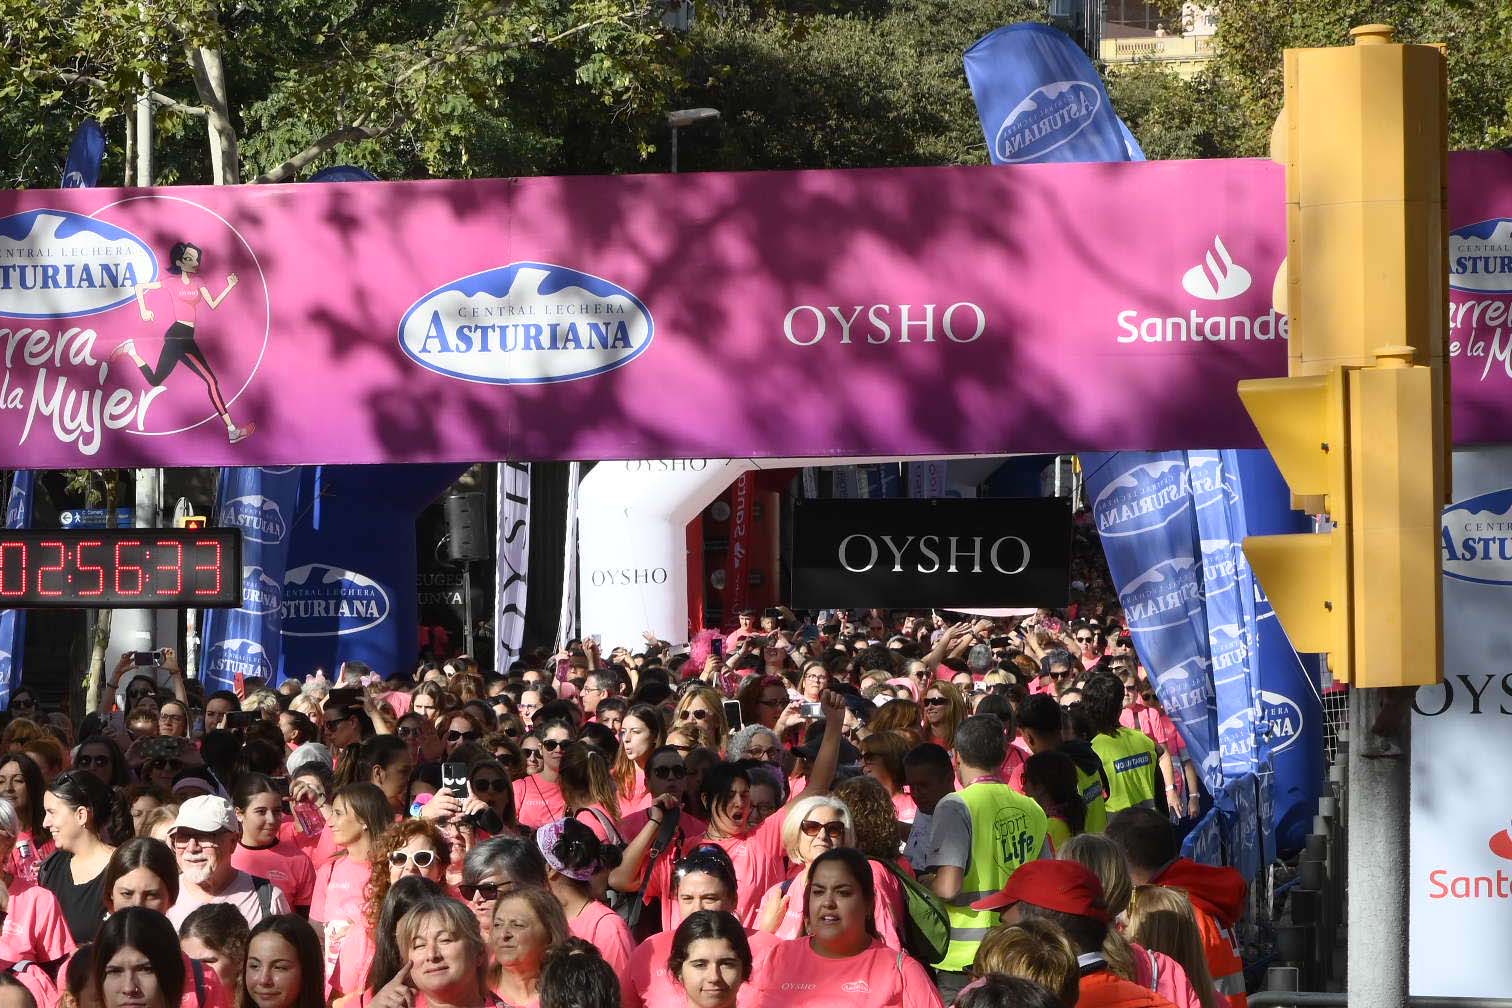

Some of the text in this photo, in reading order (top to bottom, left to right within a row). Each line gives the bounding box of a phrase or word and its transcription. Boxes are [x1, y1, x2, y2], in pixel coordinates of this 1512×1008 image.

[61, 245, 135, 258] LECHERA
[457, 302, 626, 318] CENTRAL LECHERA
[782, 301, 987, 346] OYSHO
[1116, 308, 1289, 344] Santande
[417, 309, 635, 355] ASTURIANA
[1467, 331, 1485, 357] la
[0, 369, 24, 411] la
[18, 360, 168, 456] Mujer
[0, 541, 222, 597] 02:56:33
[837, 534, 1031, 576] OYSHO
[591, 567, 668, 588] OYSHO
[281, 599, 381, 619] STURIANA
[1001, 831, 1035, 865] Life
